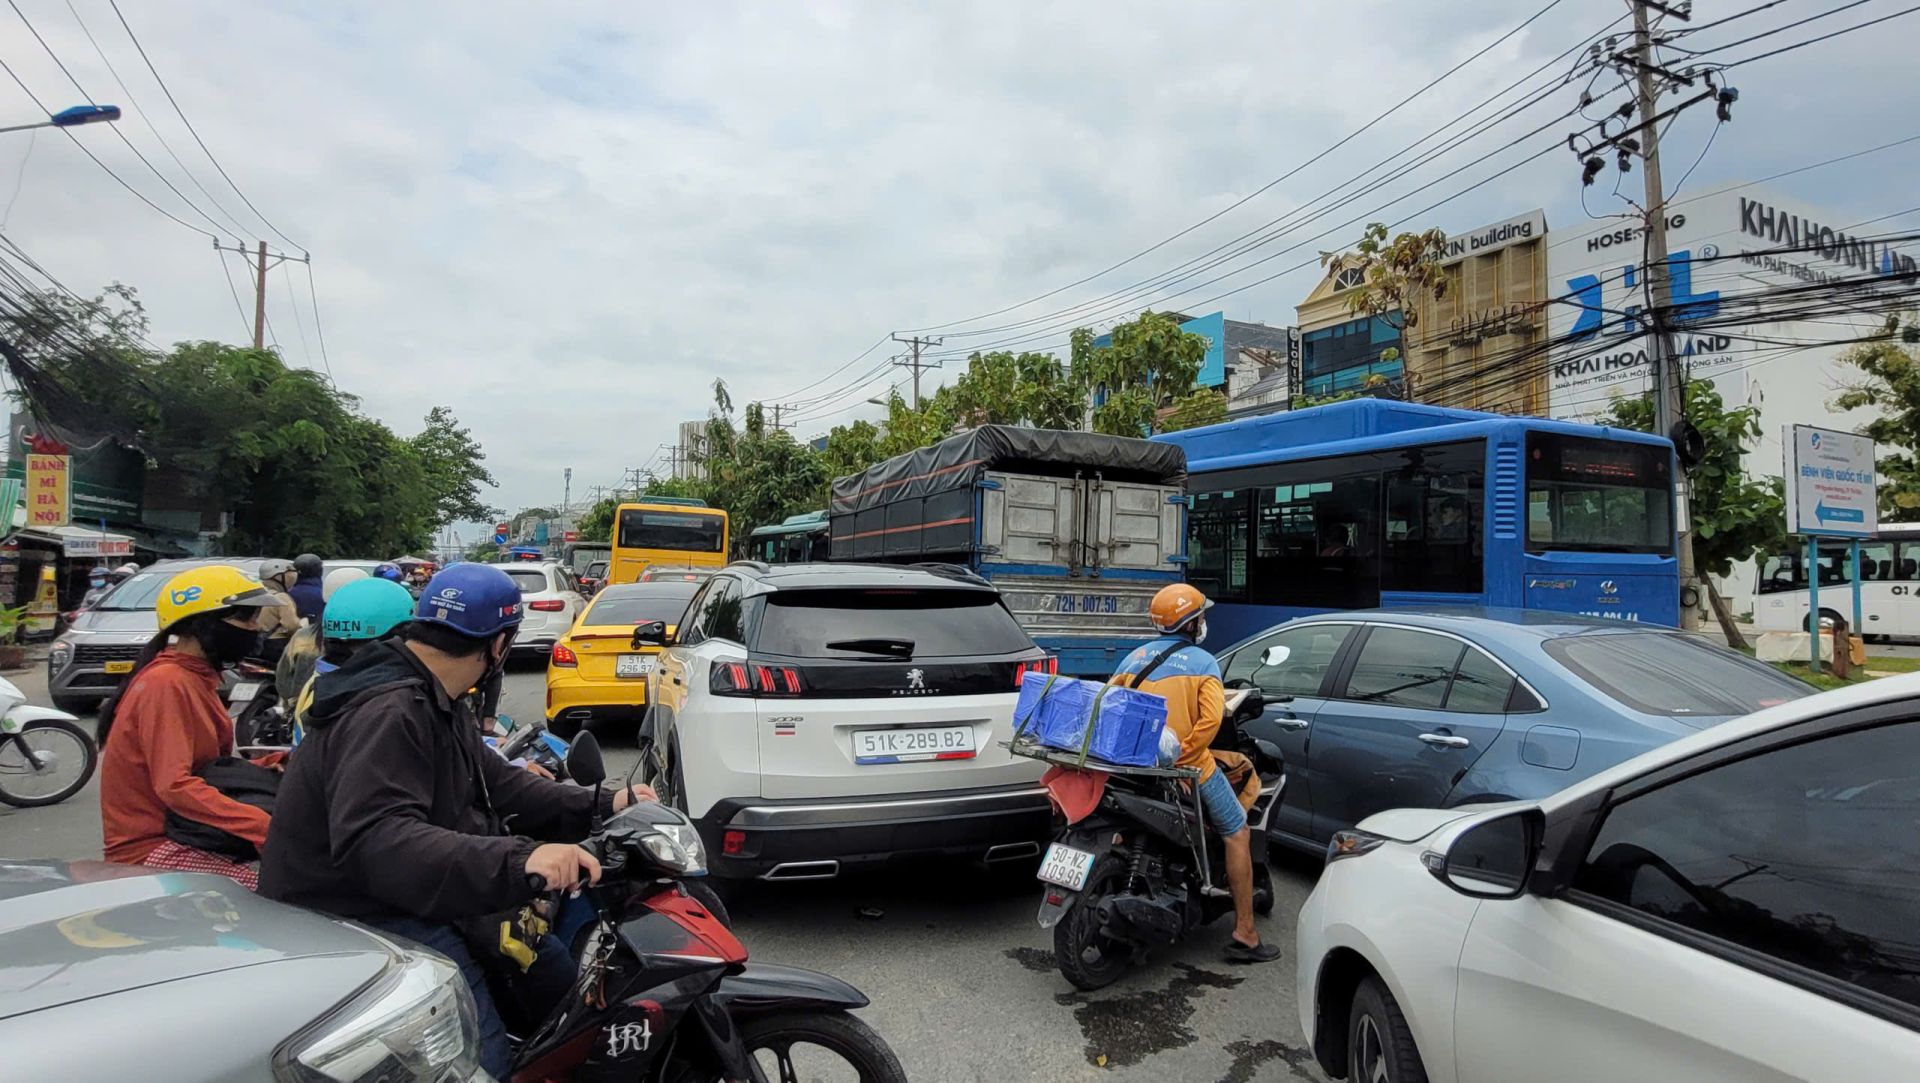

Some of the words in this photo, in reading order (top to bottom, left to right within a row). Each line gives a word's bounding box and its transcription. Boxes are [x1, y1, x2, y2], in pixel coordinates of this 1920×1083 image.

[1471, 221, 1532, 250] building
[1740, 197, 1799, 249] KHAI
[1803, 219, 1867, 271] HOAN
[1554, 357, 1600, 379] KHAI
[1605, 350, 1650, 371] HOA
[1682, 336, 1731, 356] AND
[170, 586, 202, 606] be
[864, 730, 966, 752] 51K-289.82
[1052, 846, 1087, 869] 50-N2
[1044, 862, 1083, 887] 109.96
